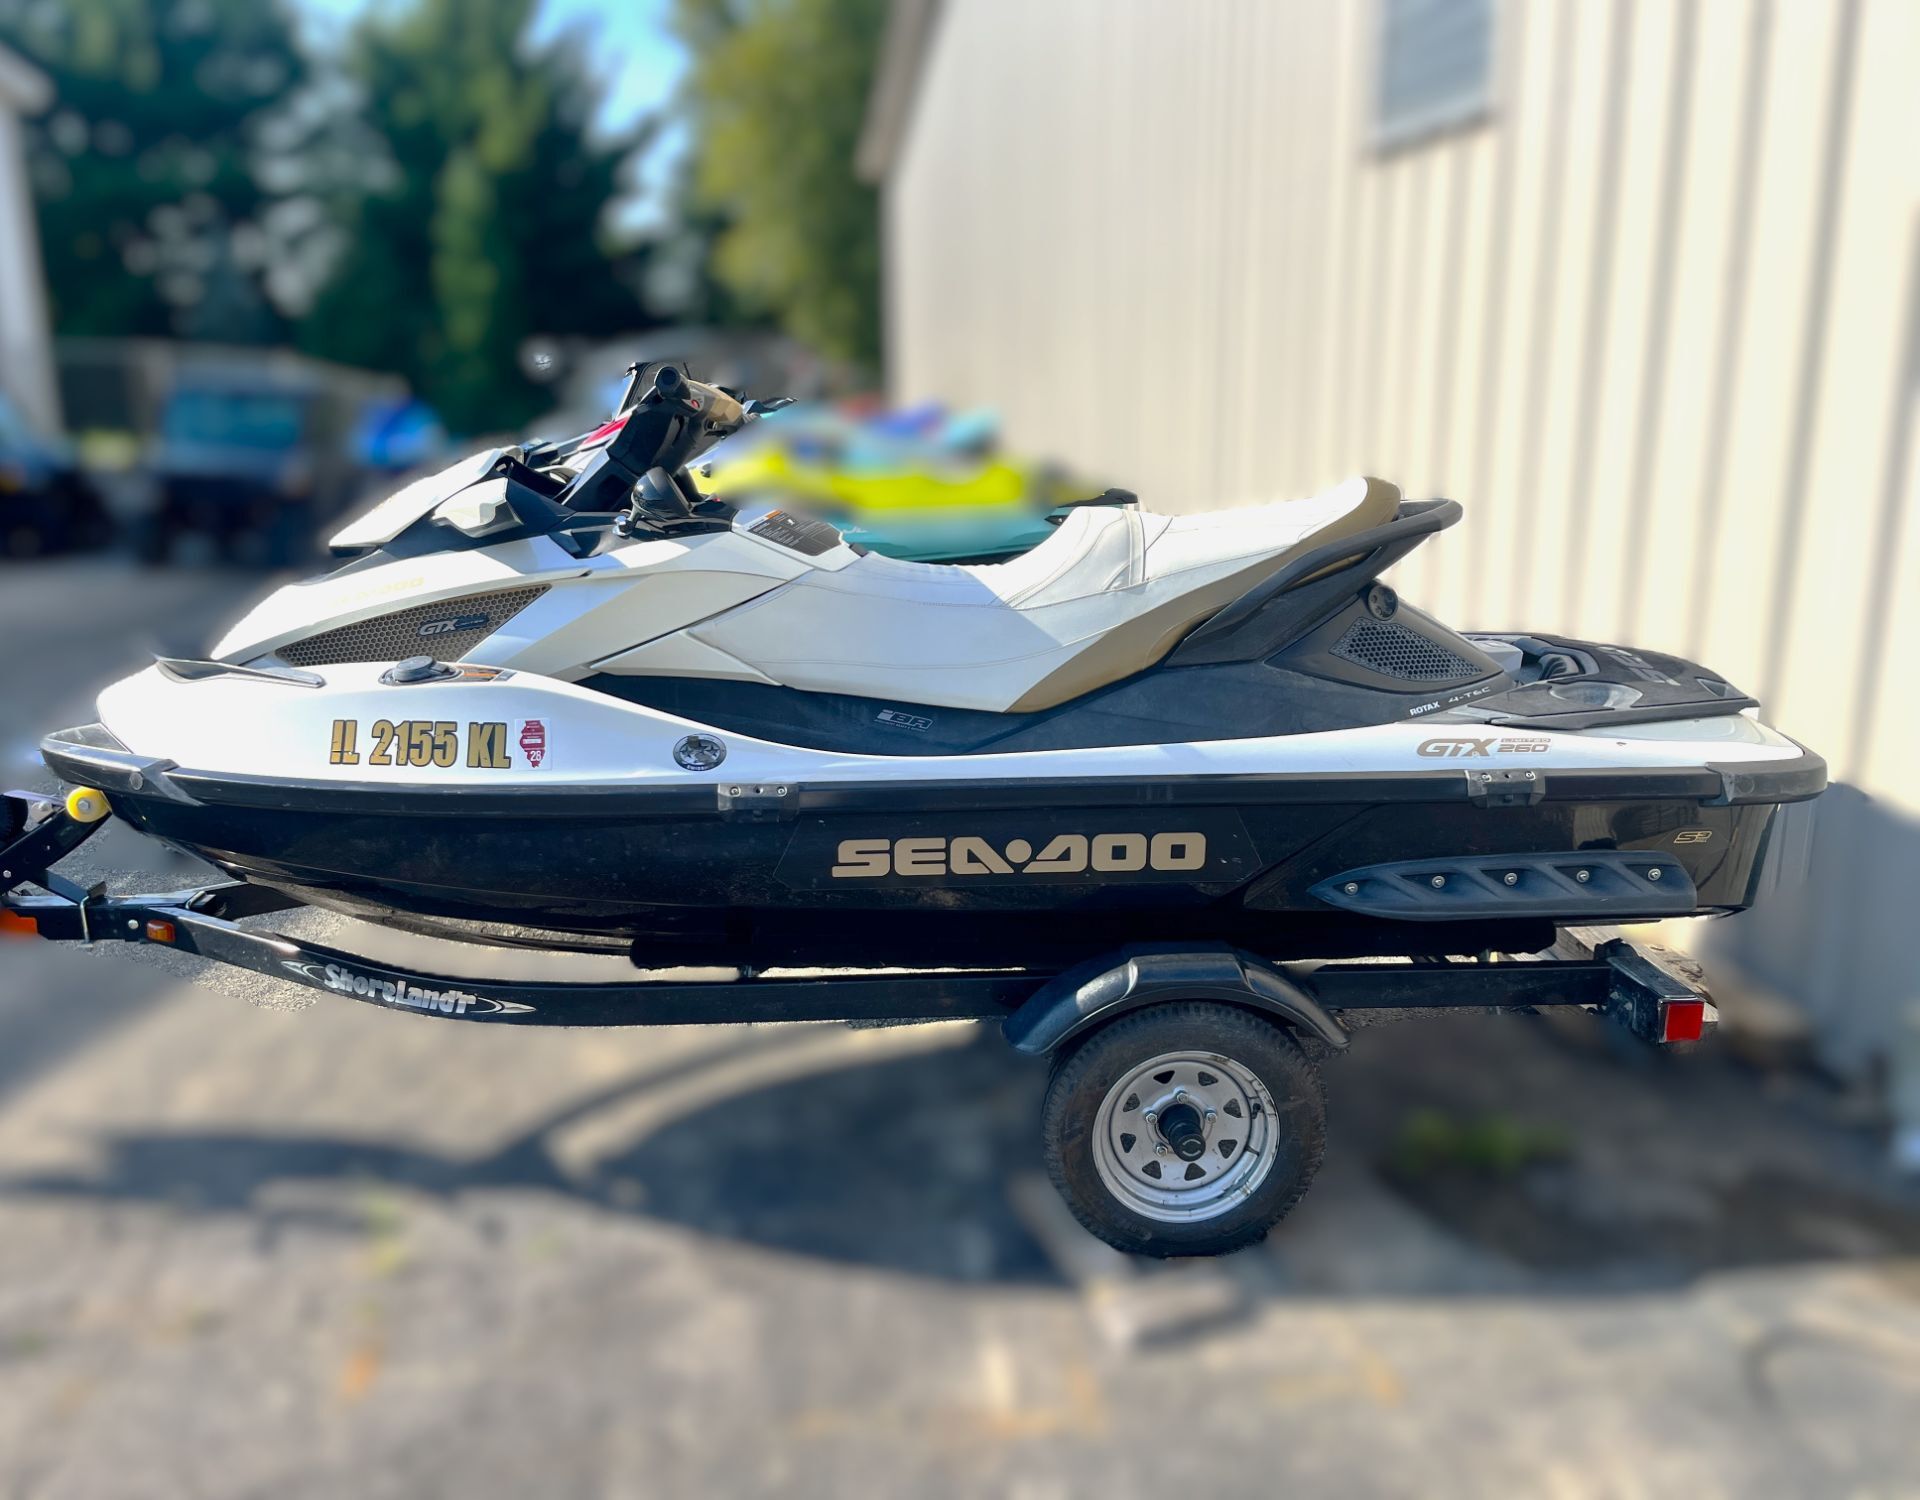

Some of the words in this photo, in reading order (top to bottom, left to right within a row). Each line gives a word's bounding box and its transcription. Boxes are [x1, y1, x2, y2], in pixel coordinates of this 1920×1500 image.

[419, 619, 459, 636] GTX
[1409, 701, 1440, 716] ROTAX
[1448, 686, 1491, 703] 4-TEC
[329, 719, 360, 765] IL
[369, 719, 458, 768] 2155
[466, 721, 511, 769] KL
[1416, 738, 1497, 757] GTX
[1497, 744, 1549, 753] 260
